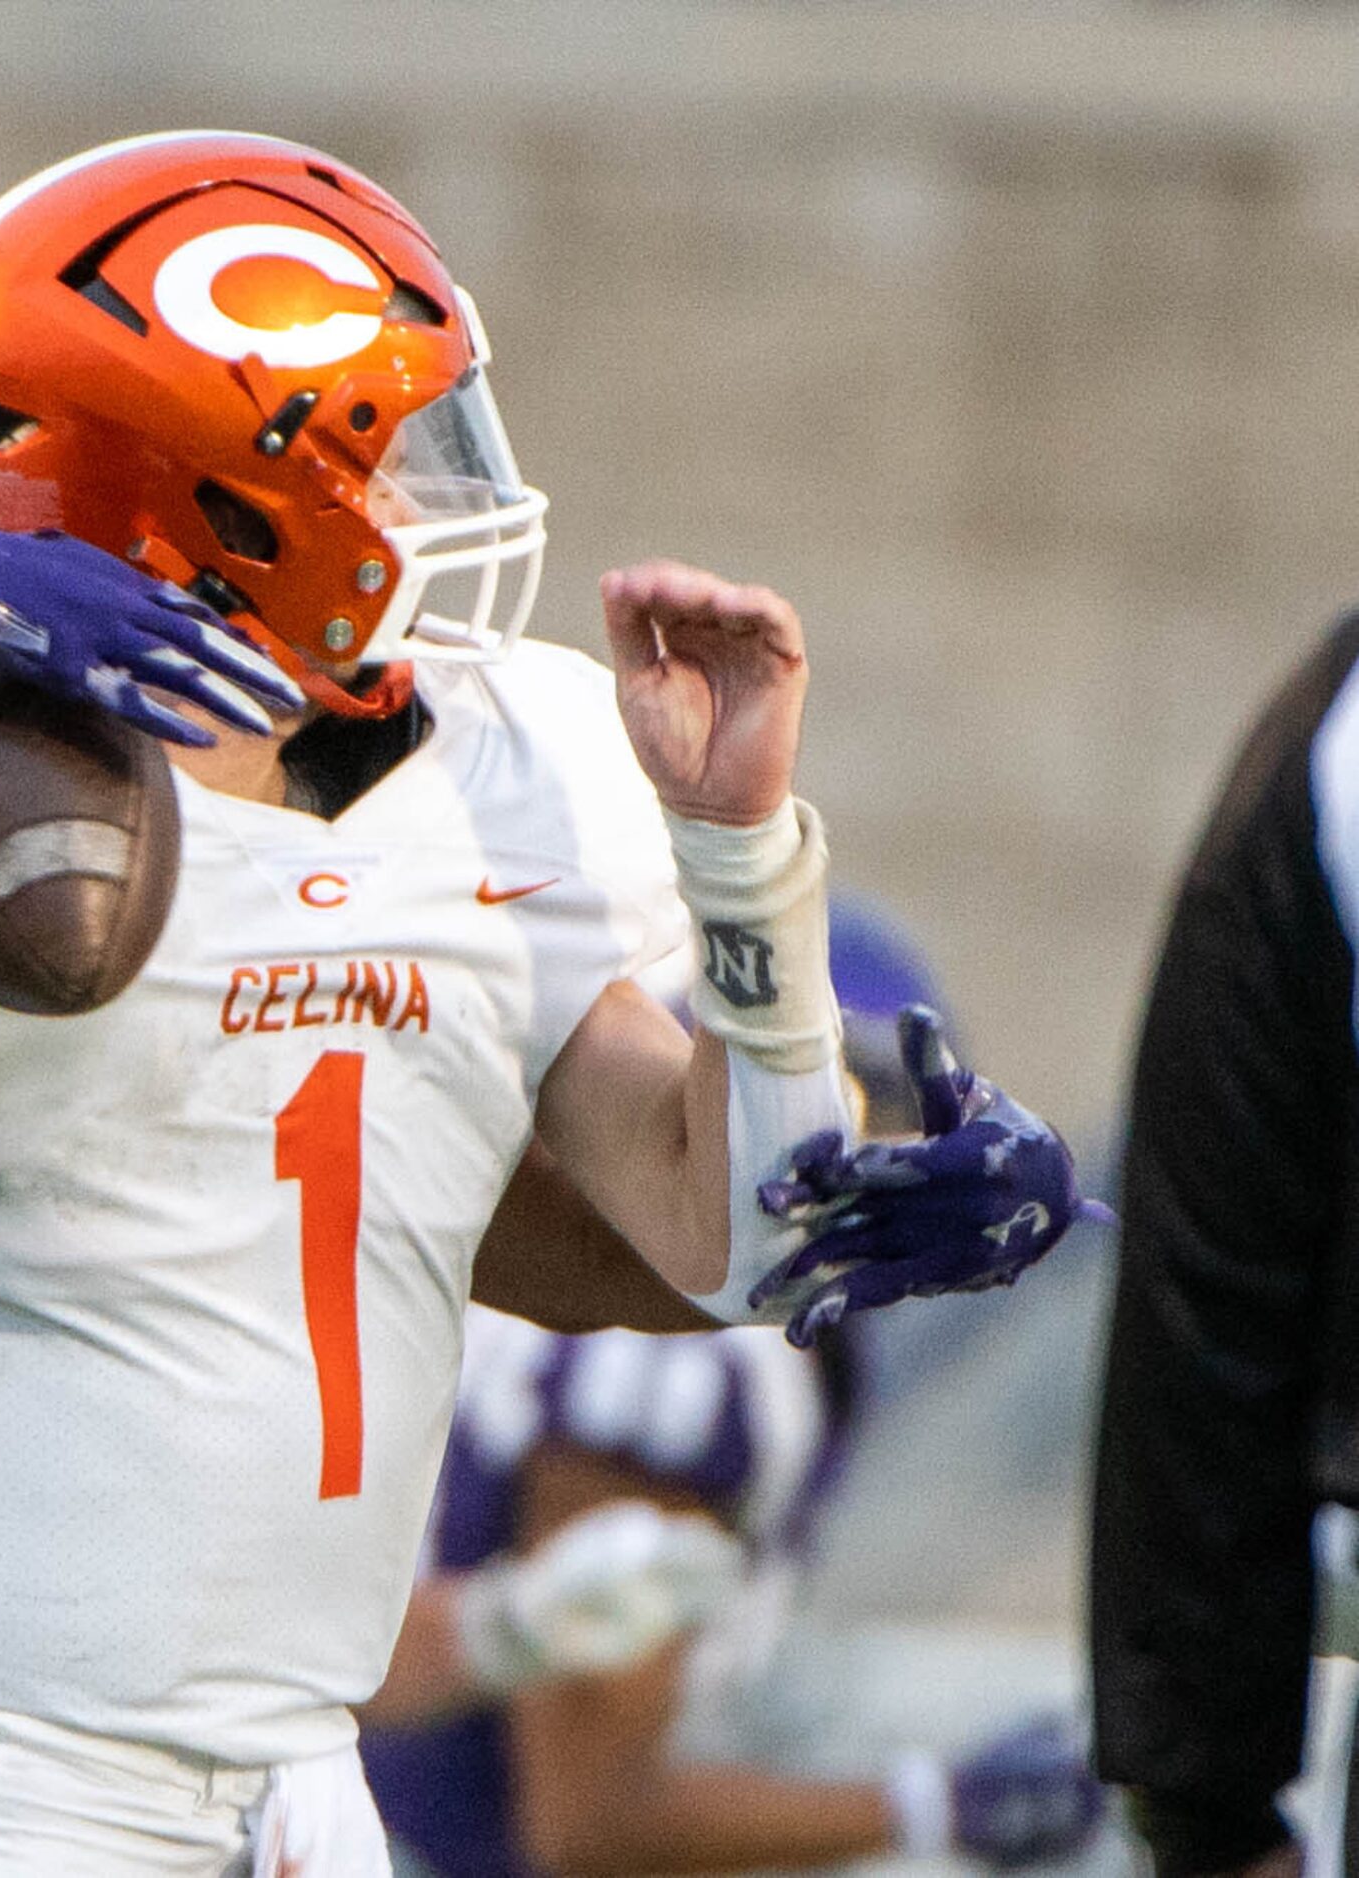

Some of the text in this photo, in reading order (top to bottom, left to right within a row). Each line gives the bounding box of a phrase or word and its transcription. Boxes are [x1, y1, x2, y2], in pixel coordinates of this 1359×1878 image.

[154, 224, 386, 367] C
[297, 871, 350, 909] C
[220, 960, 431, 1035] CELINA
[274, 1049, 365, 1500] 1
